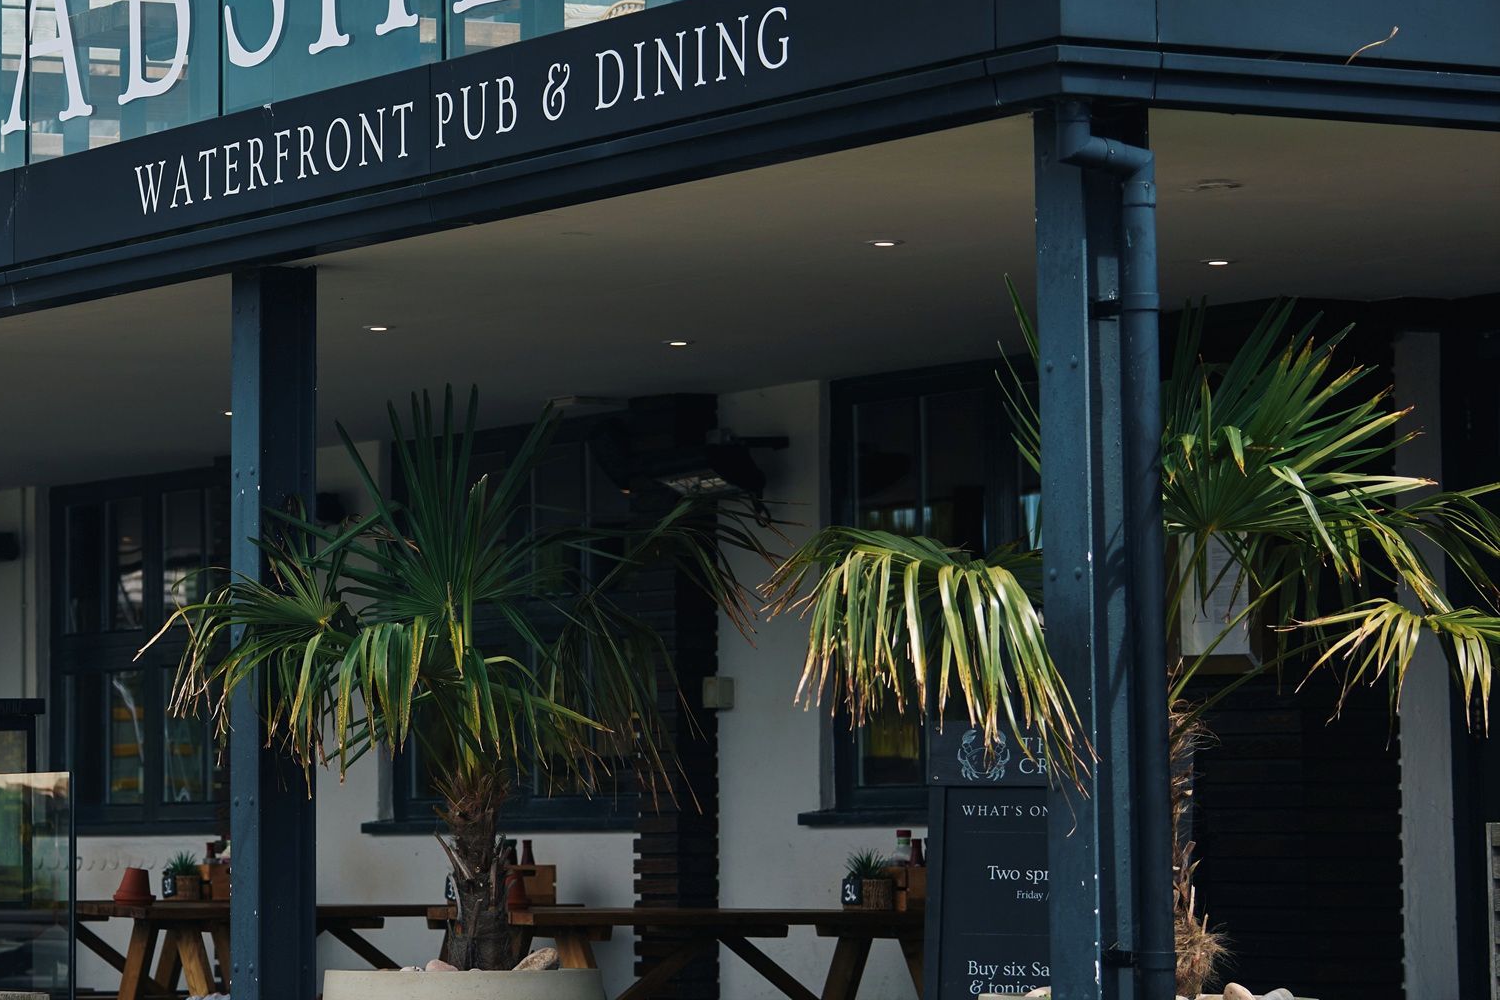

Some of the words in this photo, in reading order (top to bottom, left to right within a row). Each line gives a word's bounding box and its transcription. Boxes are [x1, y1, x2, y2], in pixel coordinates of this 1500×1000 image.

[134, 102, 414, 215] WATERFRONT
[436, 76, 517, 149] PUB
[542, 63, 570, 121] &
[595, 6, 790, 110] DINING
[962, 805, 1023, 817] WHAT'S
[987, 865, 1021, 880] Two
[845, 884, 857, 901] 34
[1016, 890, 1044, 901] Friday
[967, 960, 999, 980] Buy
[1003, 961, 1027, 977] six
[969, 980, 984, 995] &
[988, 981, 1037, 994] tonics
